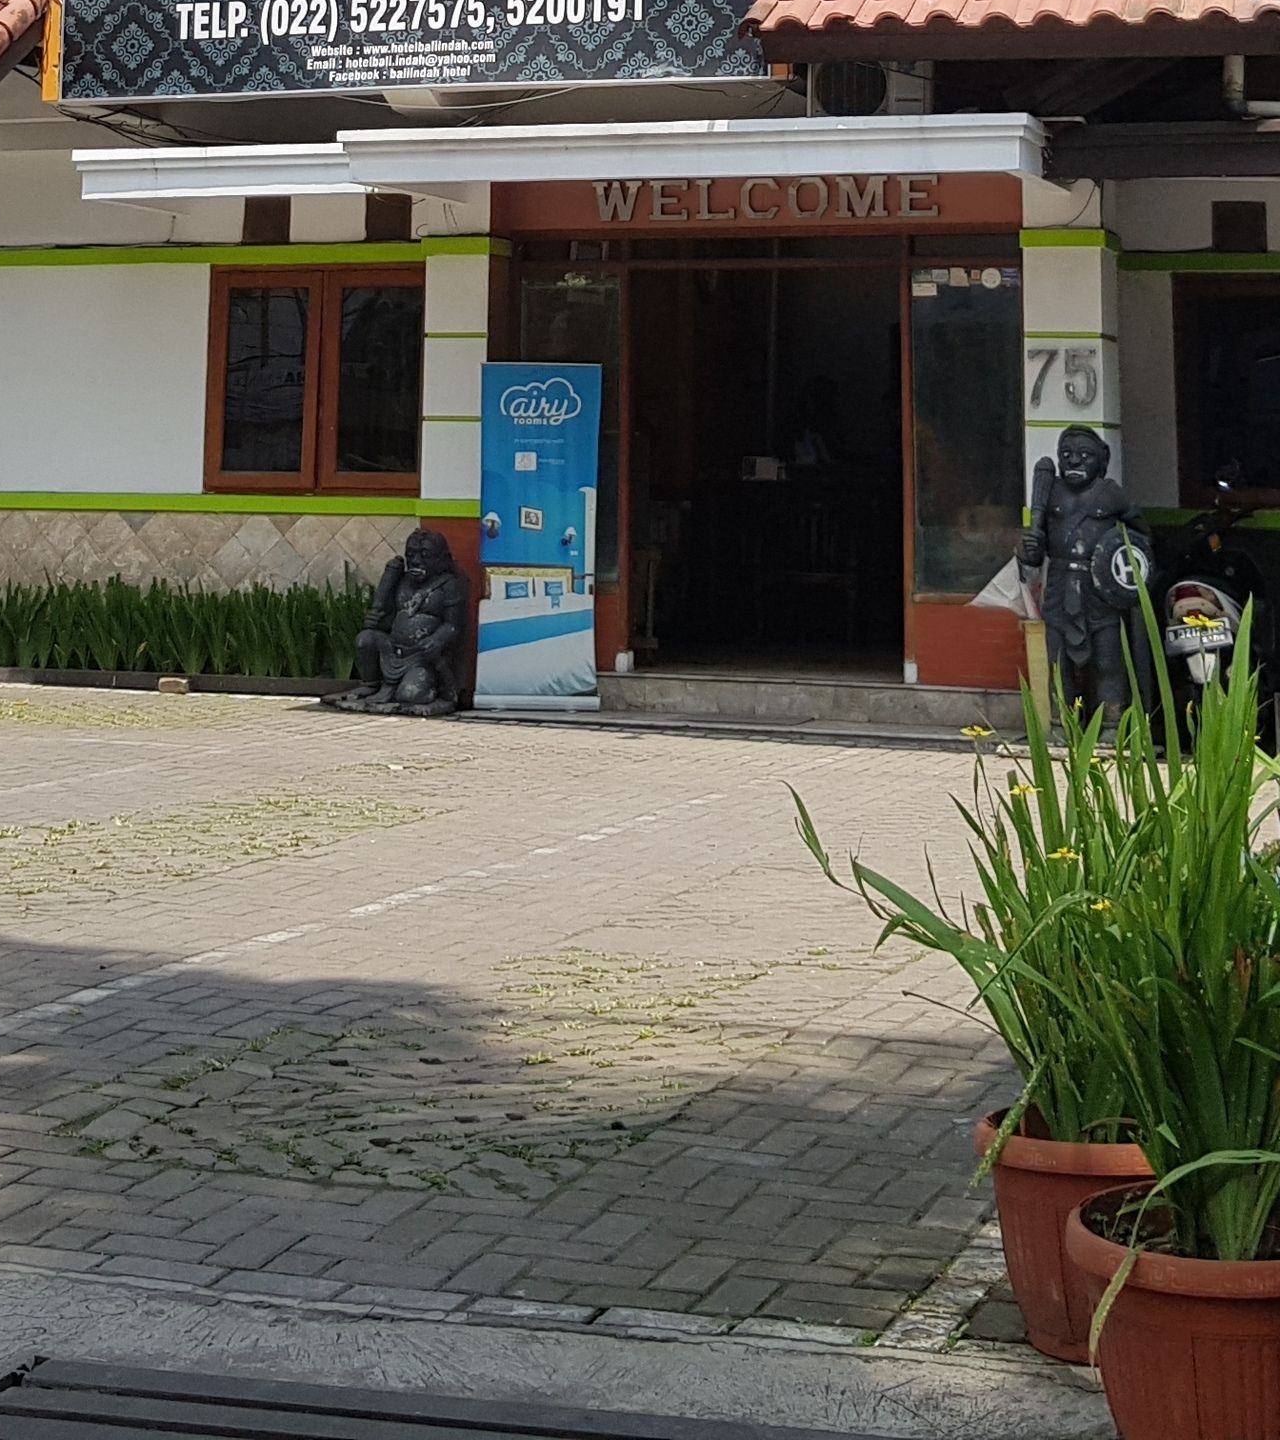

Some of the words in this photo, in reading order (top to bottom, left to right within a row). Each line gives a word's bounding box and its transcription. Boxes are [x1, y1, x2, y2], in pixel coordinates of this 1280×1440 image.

[176, 0, 249, 41] TELP.
[311, 45, 353, 57] Website
[306, 58, 336, 71] Email
[328, 68, 380, 82] Facebook
[442, 65, 471, 78] hotel
[591, 173, 940, 222] WELCOME
[1026, 348, 1098, 408] 75
[510, 390, 569, 425] airy
[514, 417, 548, 425] rooms
